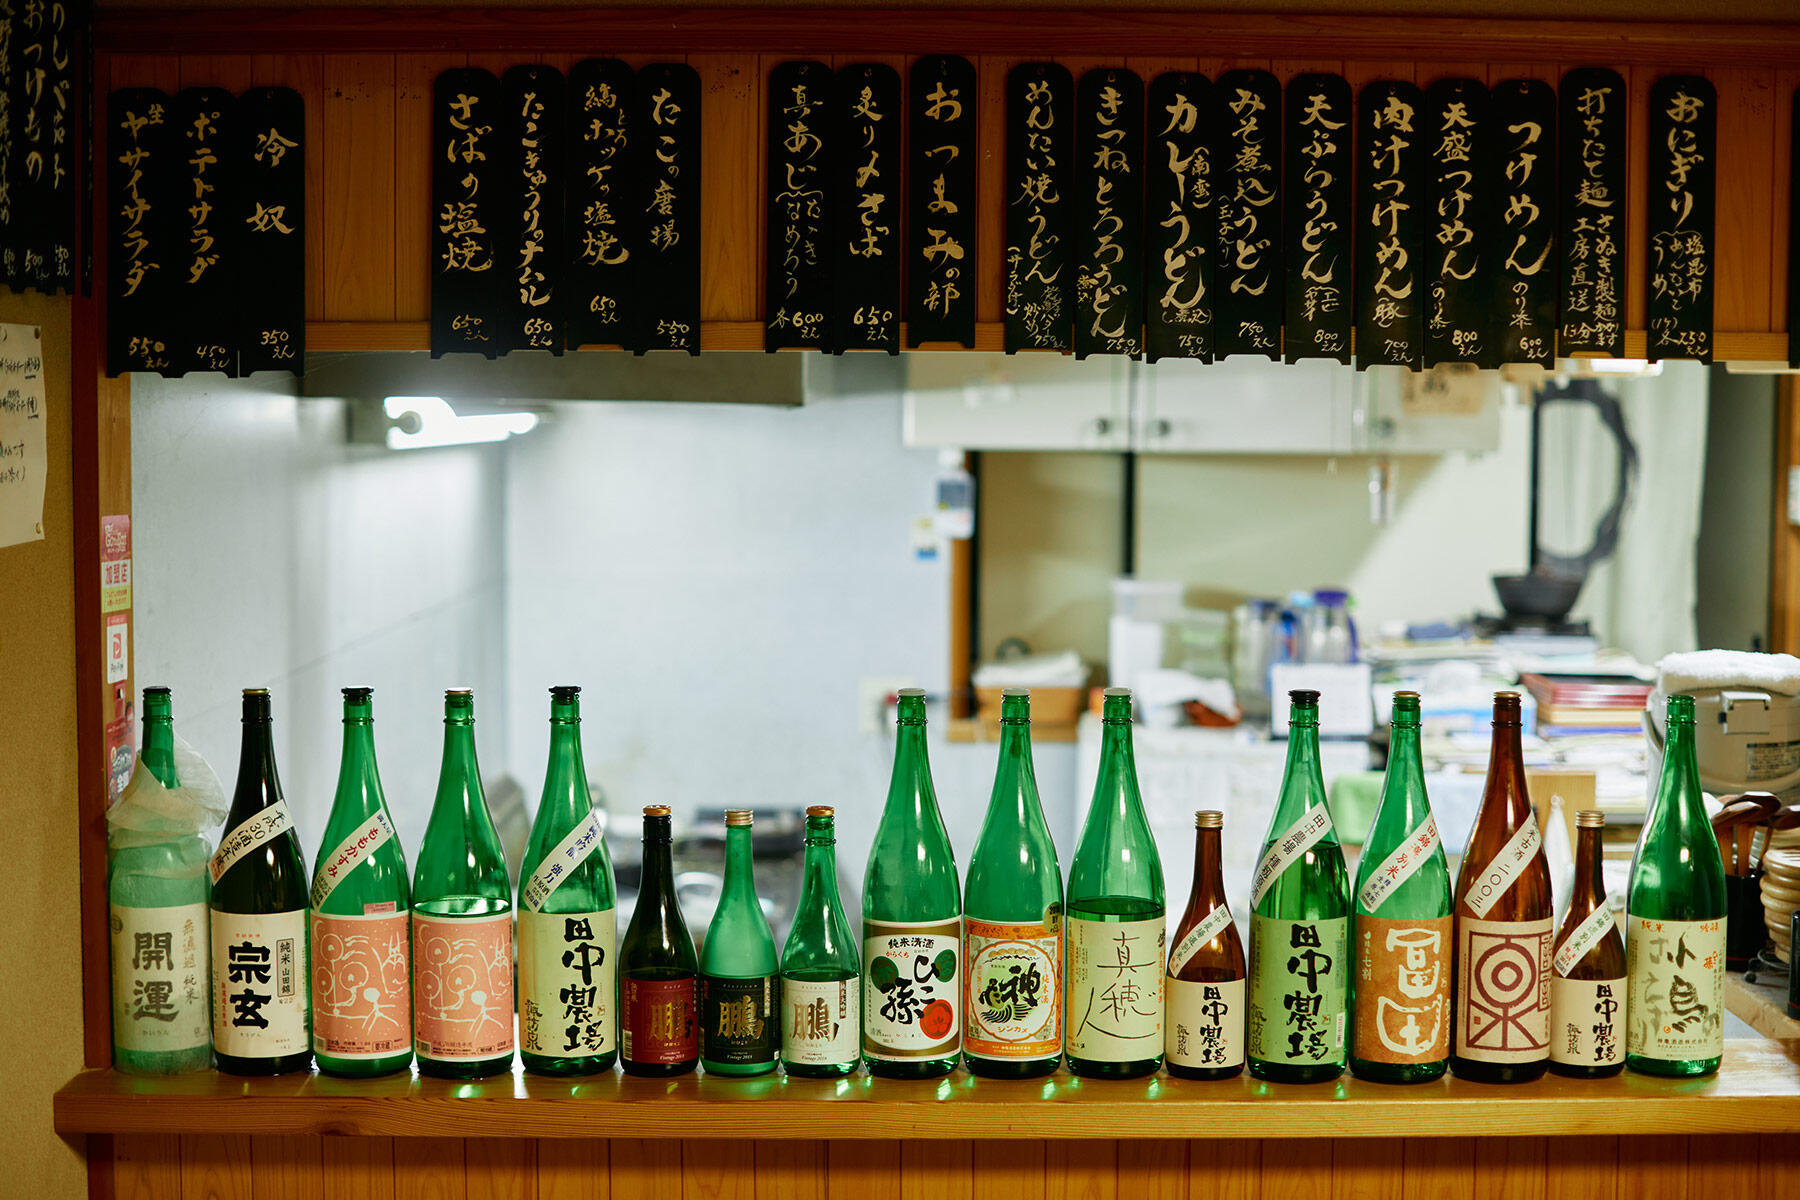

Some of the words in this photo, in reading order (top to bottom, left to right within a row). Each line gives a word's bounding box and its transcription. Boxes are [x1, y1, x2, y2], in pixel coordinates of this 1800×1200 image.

[645, 87, 682, 253] たこの唐揚
[783, 84, 824, 190] 真あじ
[1664, 90, 1705, 229] おにぎり
[119, 111, 161, 298] ヤサイサラダ
[184, 111, 221, 285] ポテトサラダ
[246, 127, 299, 235] 冷奴
[440, 92, 494, 276] さばの塩焼
[514, 91, 553, 307] たこきゅうりのナムル
[922, 81, 966, 320] おつまみの部
[1010, 80, 1064, 285] めんたい焼うどん
[1091, 86, 1131, 338] きつねとろろうどん
[1158, 93, 1206, 310] カレーうどん
[1225, 88, 1278, 297] みそ煮込うどん
[1298, 93, 1348, 284] 天ぷらうどん
[1370, 95, 1416, 300] 肉汁つけめん
[1432, 101, 1479, 281] 天盛つけめん
[1503, 121, 1555, 277] つけめん
[1567, 216, 1596, 313] 工房直送
[1652, 238, 1668, 302] うめ
[1685, 236, 1709, 305] 塩昆布
[260, 330, 290, 346] 350
[451, 313, 483, 331] 650
[523, 317, 553, 336] 650
[589, 295, 617, 314] 650
[656, 319, 690, 335] 550
[853, 306, 894, 326] 650
[1178, 334, 1204, 349] 750
[1313, 328, 1339, 344] 800
[1451, 329, 1479, 346] 800
[128, 336, 166, 357] 550
[1106, 336, 1136, 353] 750
[1384, 338, 1409, 356] 700
[1519, 336, 1543, 351] 600
[327, 826, 378, 879] ももかすみ
[1283, 813, 1326, 855] 田中農場
[543, 862, 563, 884] 強力
[132, 931, 180, 1023] 開運
[280, 941, 291, 964] 純米
[885, 951, 910, 959] からくち
[888, 936, 935, 949] 純米清酒
[228, 941, 272, 1031] 宗玄
[559, 917, 605, 1052] 田中農場
[717, 994, 765, 1040] 鵬
[789, 997, 839, 1042] 鵬
[1284, 923, 1333, 1061] 田中農場
[997, 1025, 1028, 1034] シンカメ
[1199, 985, 1229, 1065] 田中農場
[1592, 984, 1619, 1063] 田中農場
